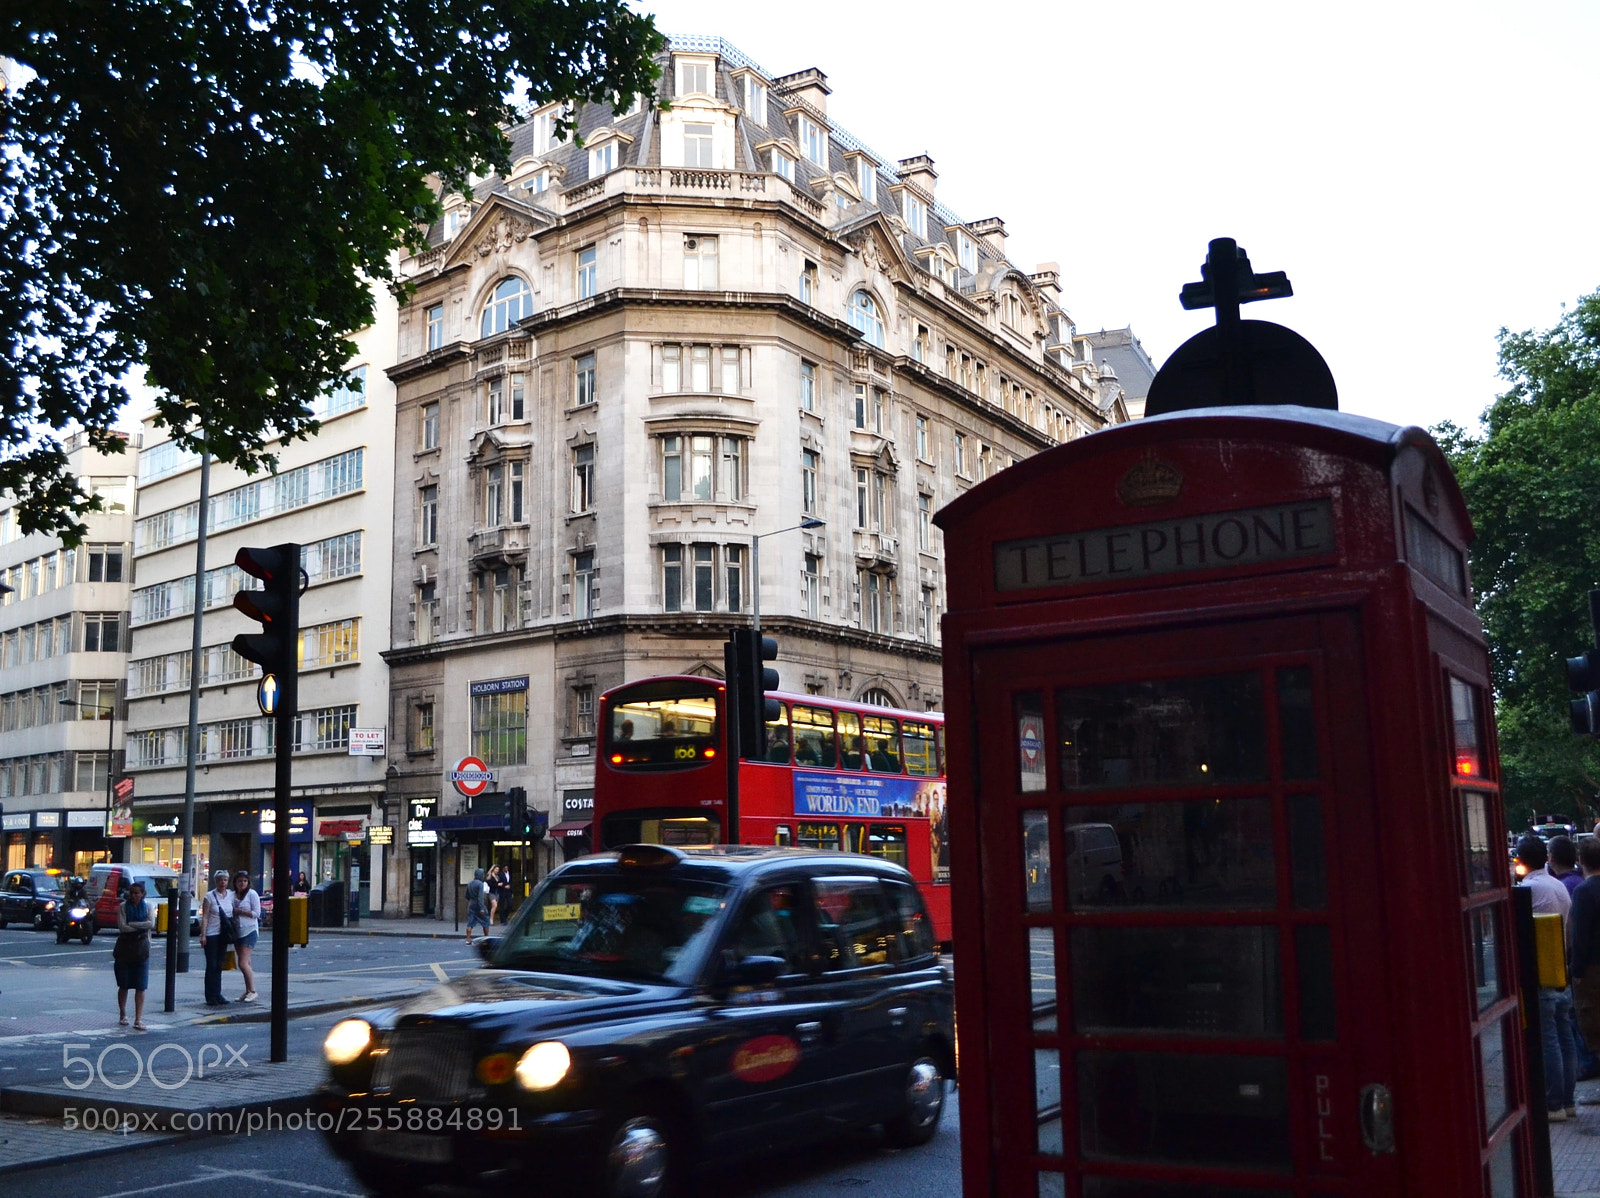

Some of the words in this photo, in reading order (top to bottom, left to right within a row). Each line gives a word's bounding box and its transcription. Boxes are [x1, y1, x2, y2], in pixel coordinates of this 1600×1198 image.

[1009, 507, 1320, 584] TELEPHONE
[472, 682, 500, 693] HOLBORN
[501, 679, 525, 690] STATION
[416, 804, 430, 818] Dry
[565, 798, 595, 810] COSTA
[856, 796, 880, 814] END
[567, 829, 583, 837] COSTA
[1314, 1074, 1334, 1161] PULL
